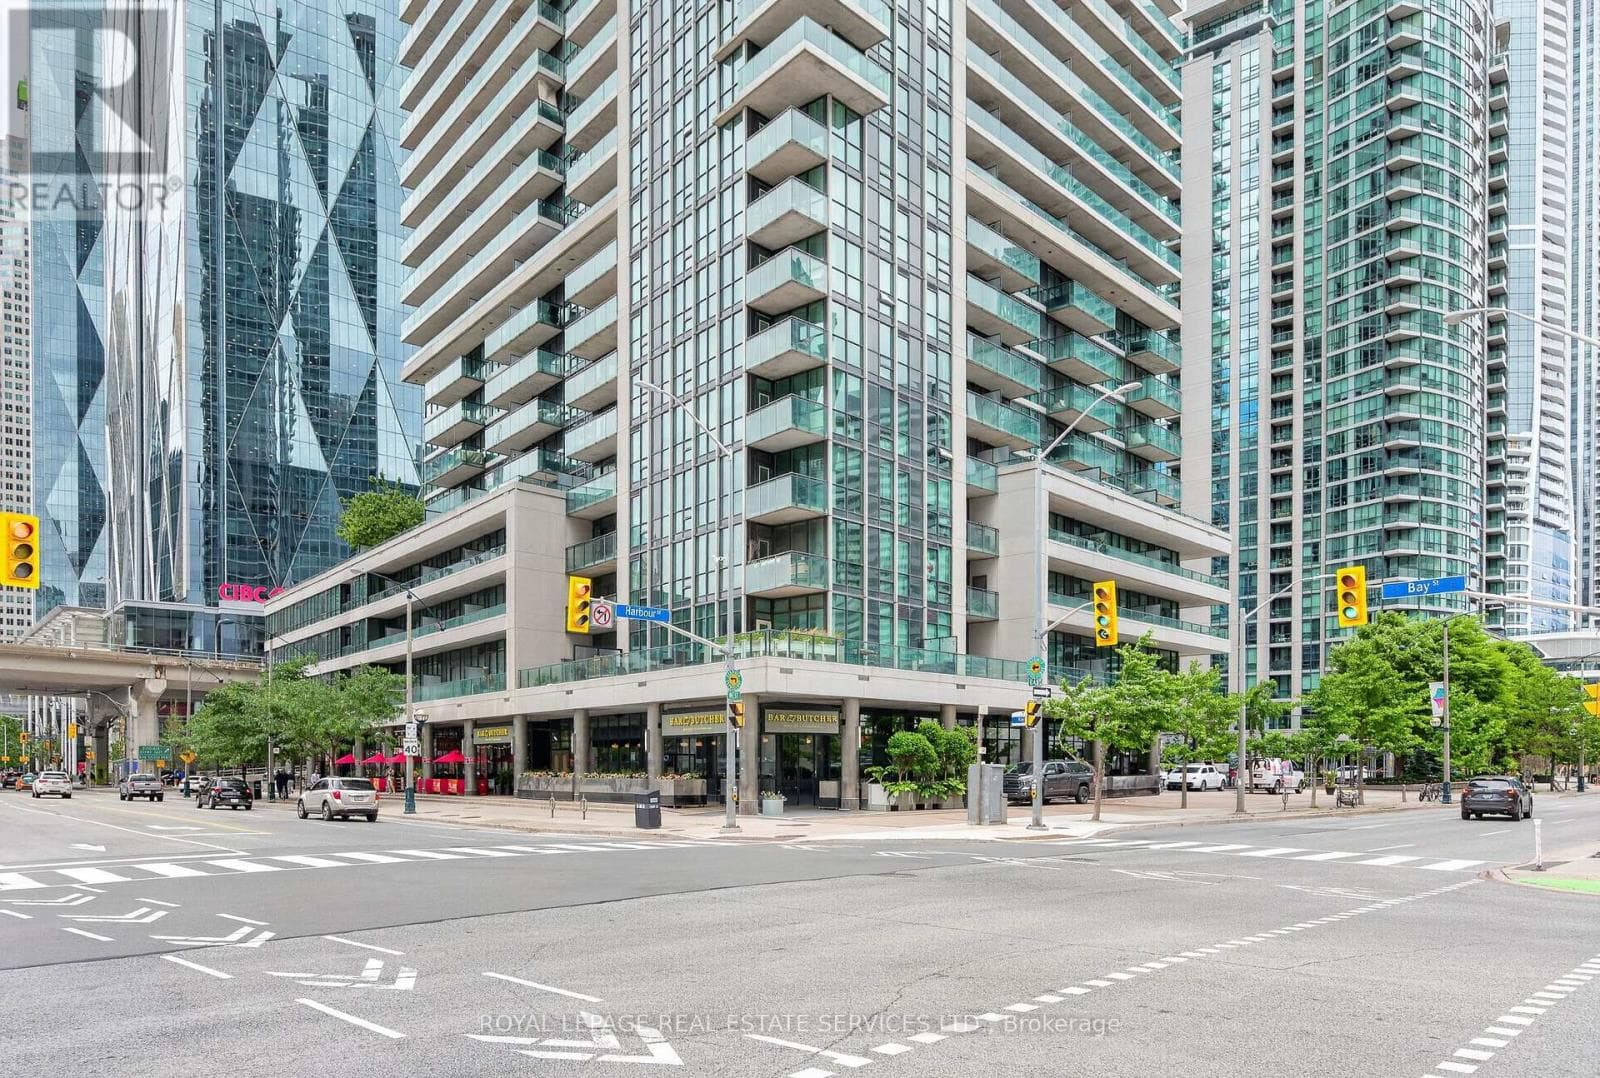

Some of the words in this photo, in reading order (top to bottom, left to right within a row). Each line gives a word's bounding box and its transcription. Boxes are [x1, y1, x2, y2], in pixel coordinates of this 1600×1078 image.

[1408, 582, 1430, 593] Bay
[218, 583, 267, 604] CIBC
[626, 606, 656, 618] Harbour
[690, 713, 726, 725] BUTCHER
[768, 713, 785, 722] BAR
[797, 713, 838, 724] BUTCHER
[404, 745, 418, 754] 40
